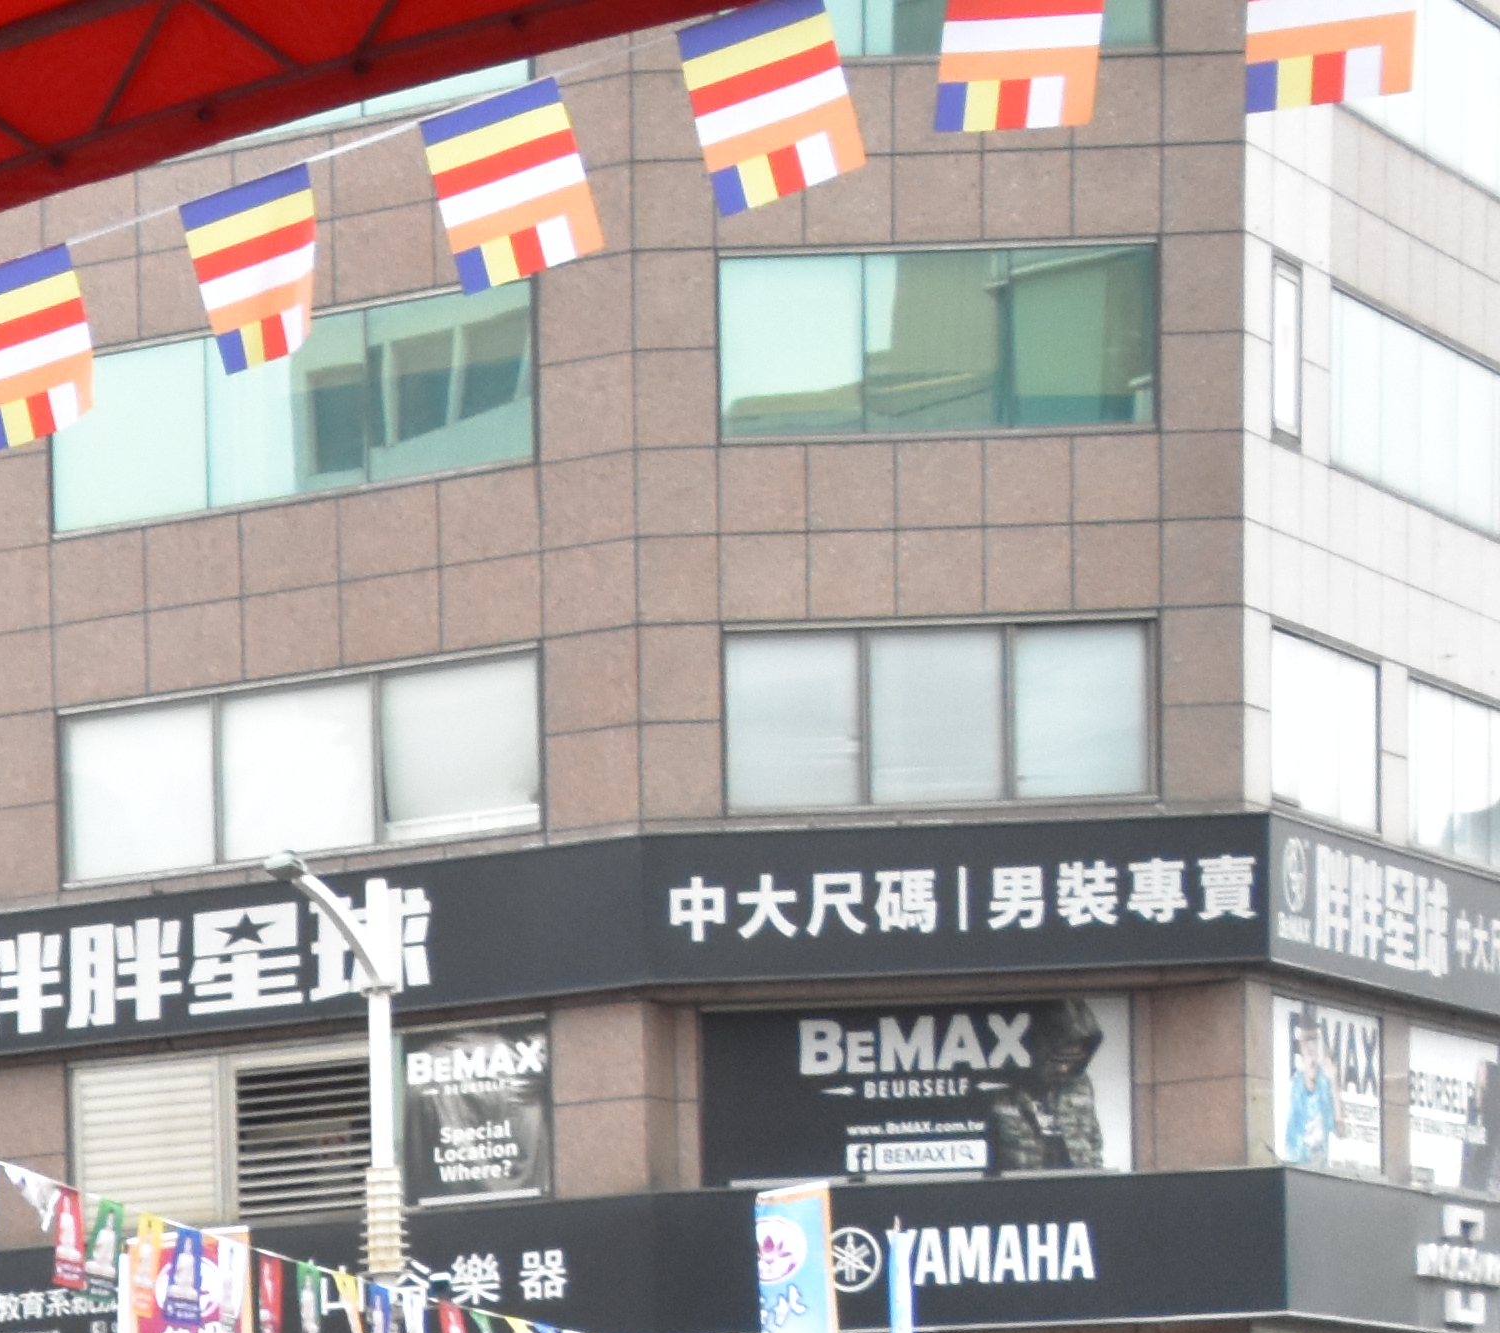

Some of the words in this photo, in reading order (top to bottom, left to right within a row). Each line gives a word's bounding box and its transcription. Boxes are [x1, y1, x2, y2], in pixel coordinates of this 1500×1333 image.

[669, 868, 938, 943] 中大尺碼
[987, 853, 1259, 933] 男裝專賣
[864, 1076, 970, 1100] BEURSELF
[439, 1120, 512, 1146] Special
[433, 1141, 520, 1164] Location
[882, 1145, 948, 1165] BEMAX
[439, 1159, 513, 1183] Where?
